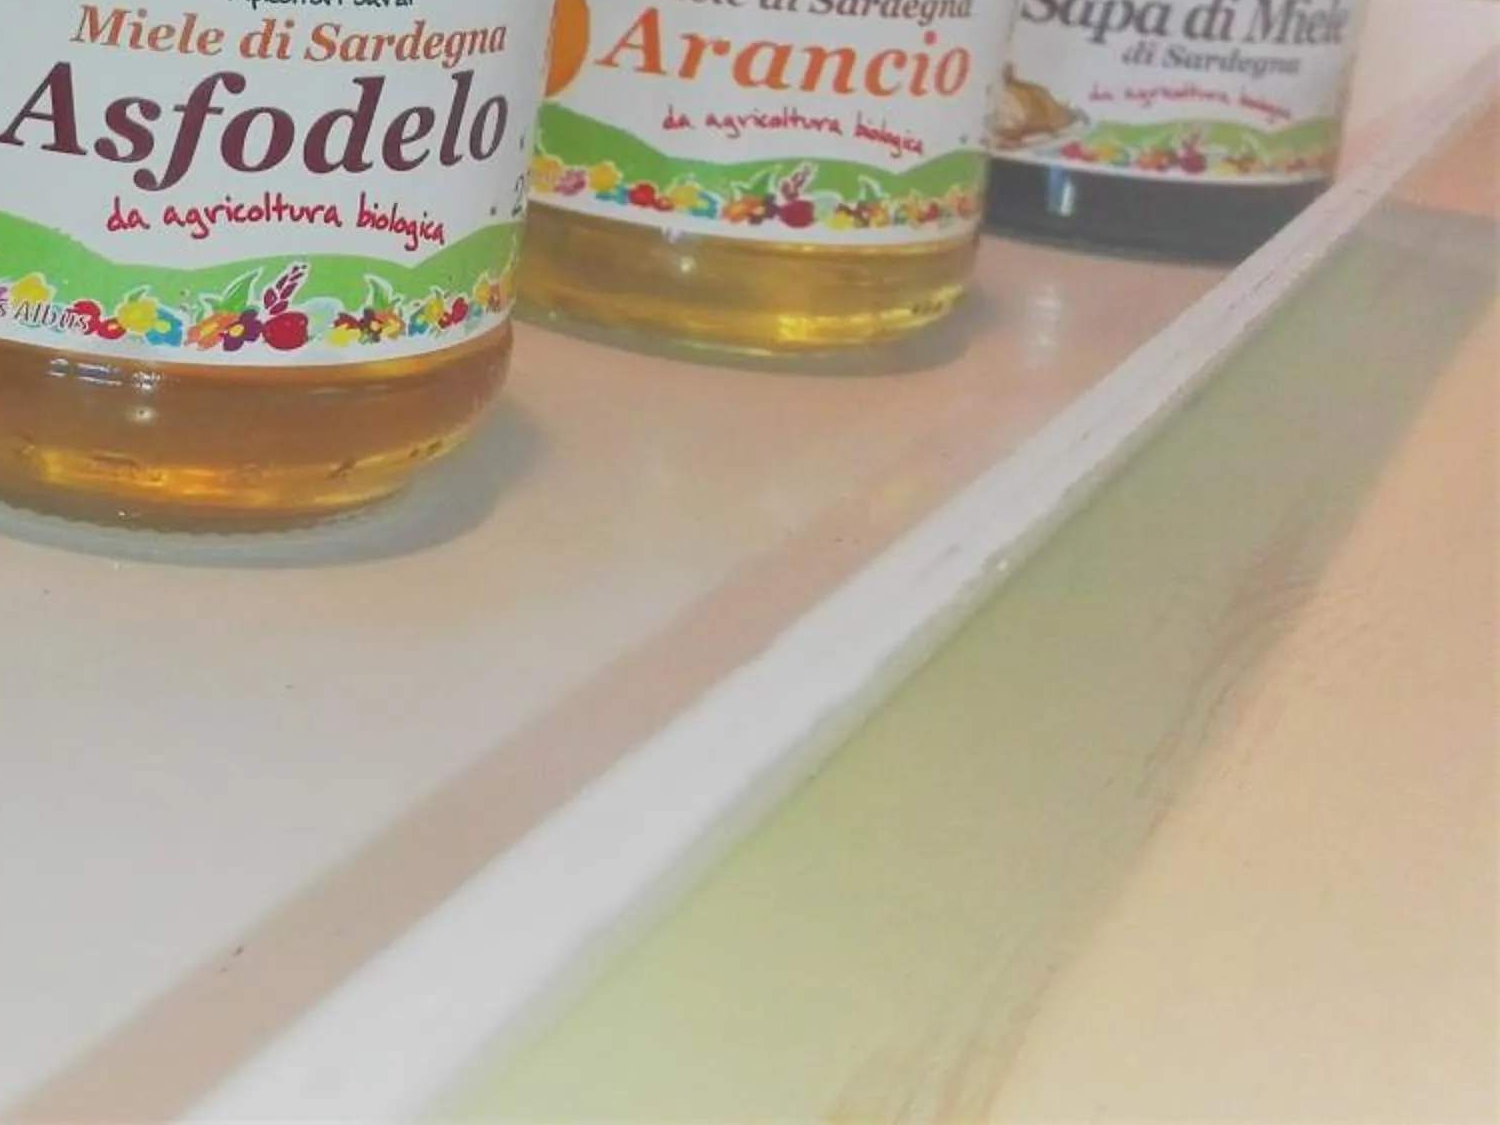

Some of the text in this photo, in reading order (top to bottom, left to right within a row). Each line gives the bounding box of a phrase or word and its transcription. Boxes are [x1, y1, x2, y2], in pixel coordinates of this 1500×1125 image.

[70, 4, 507, 69] Miele di Sardegna
[594, 5, 973, 98] Arancio
[1121, 40, 1302, 79] di Sardegna
[661, 104, 924, 160] da agricoltura biologica
[106, 190, 445, 252] da agricoltura biologica
[13, 300, 90, 333] Albus
